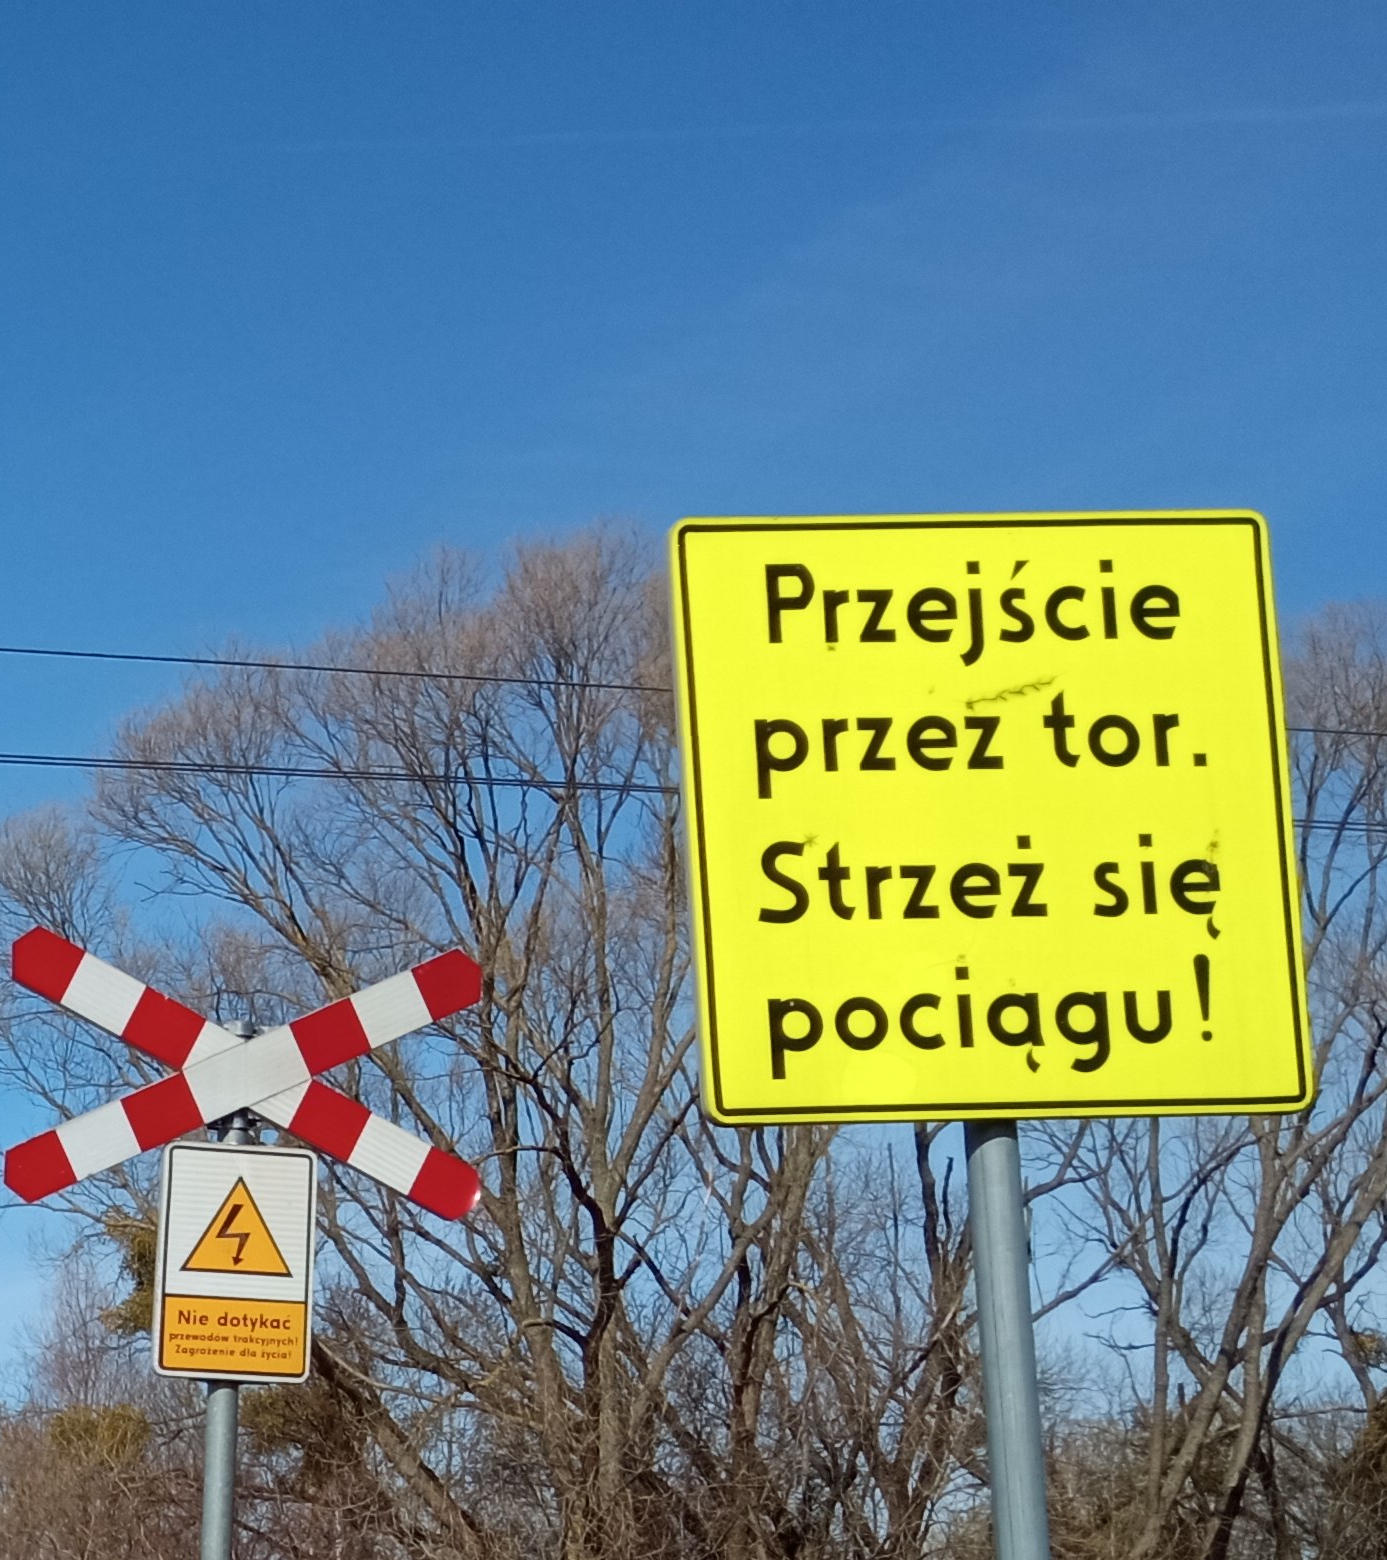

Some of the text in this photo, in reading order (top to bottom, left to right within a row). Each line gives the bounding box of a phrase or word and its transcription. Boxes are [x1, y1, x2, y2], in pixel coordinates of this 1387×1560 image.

[765, 560, 1180, 667] Przejście
[755, 693, 1207, 799] przez tor.
[758, 834, 1221, 939] Strzeż się
[767, 954, 1213, 1080] pociągu!
[169, 1332, 299, 1347] przewodów trakcyjnych!
[177, 1310, 291, 1332] Nie dotykać
[239, 1348, 257, 1357] dla
